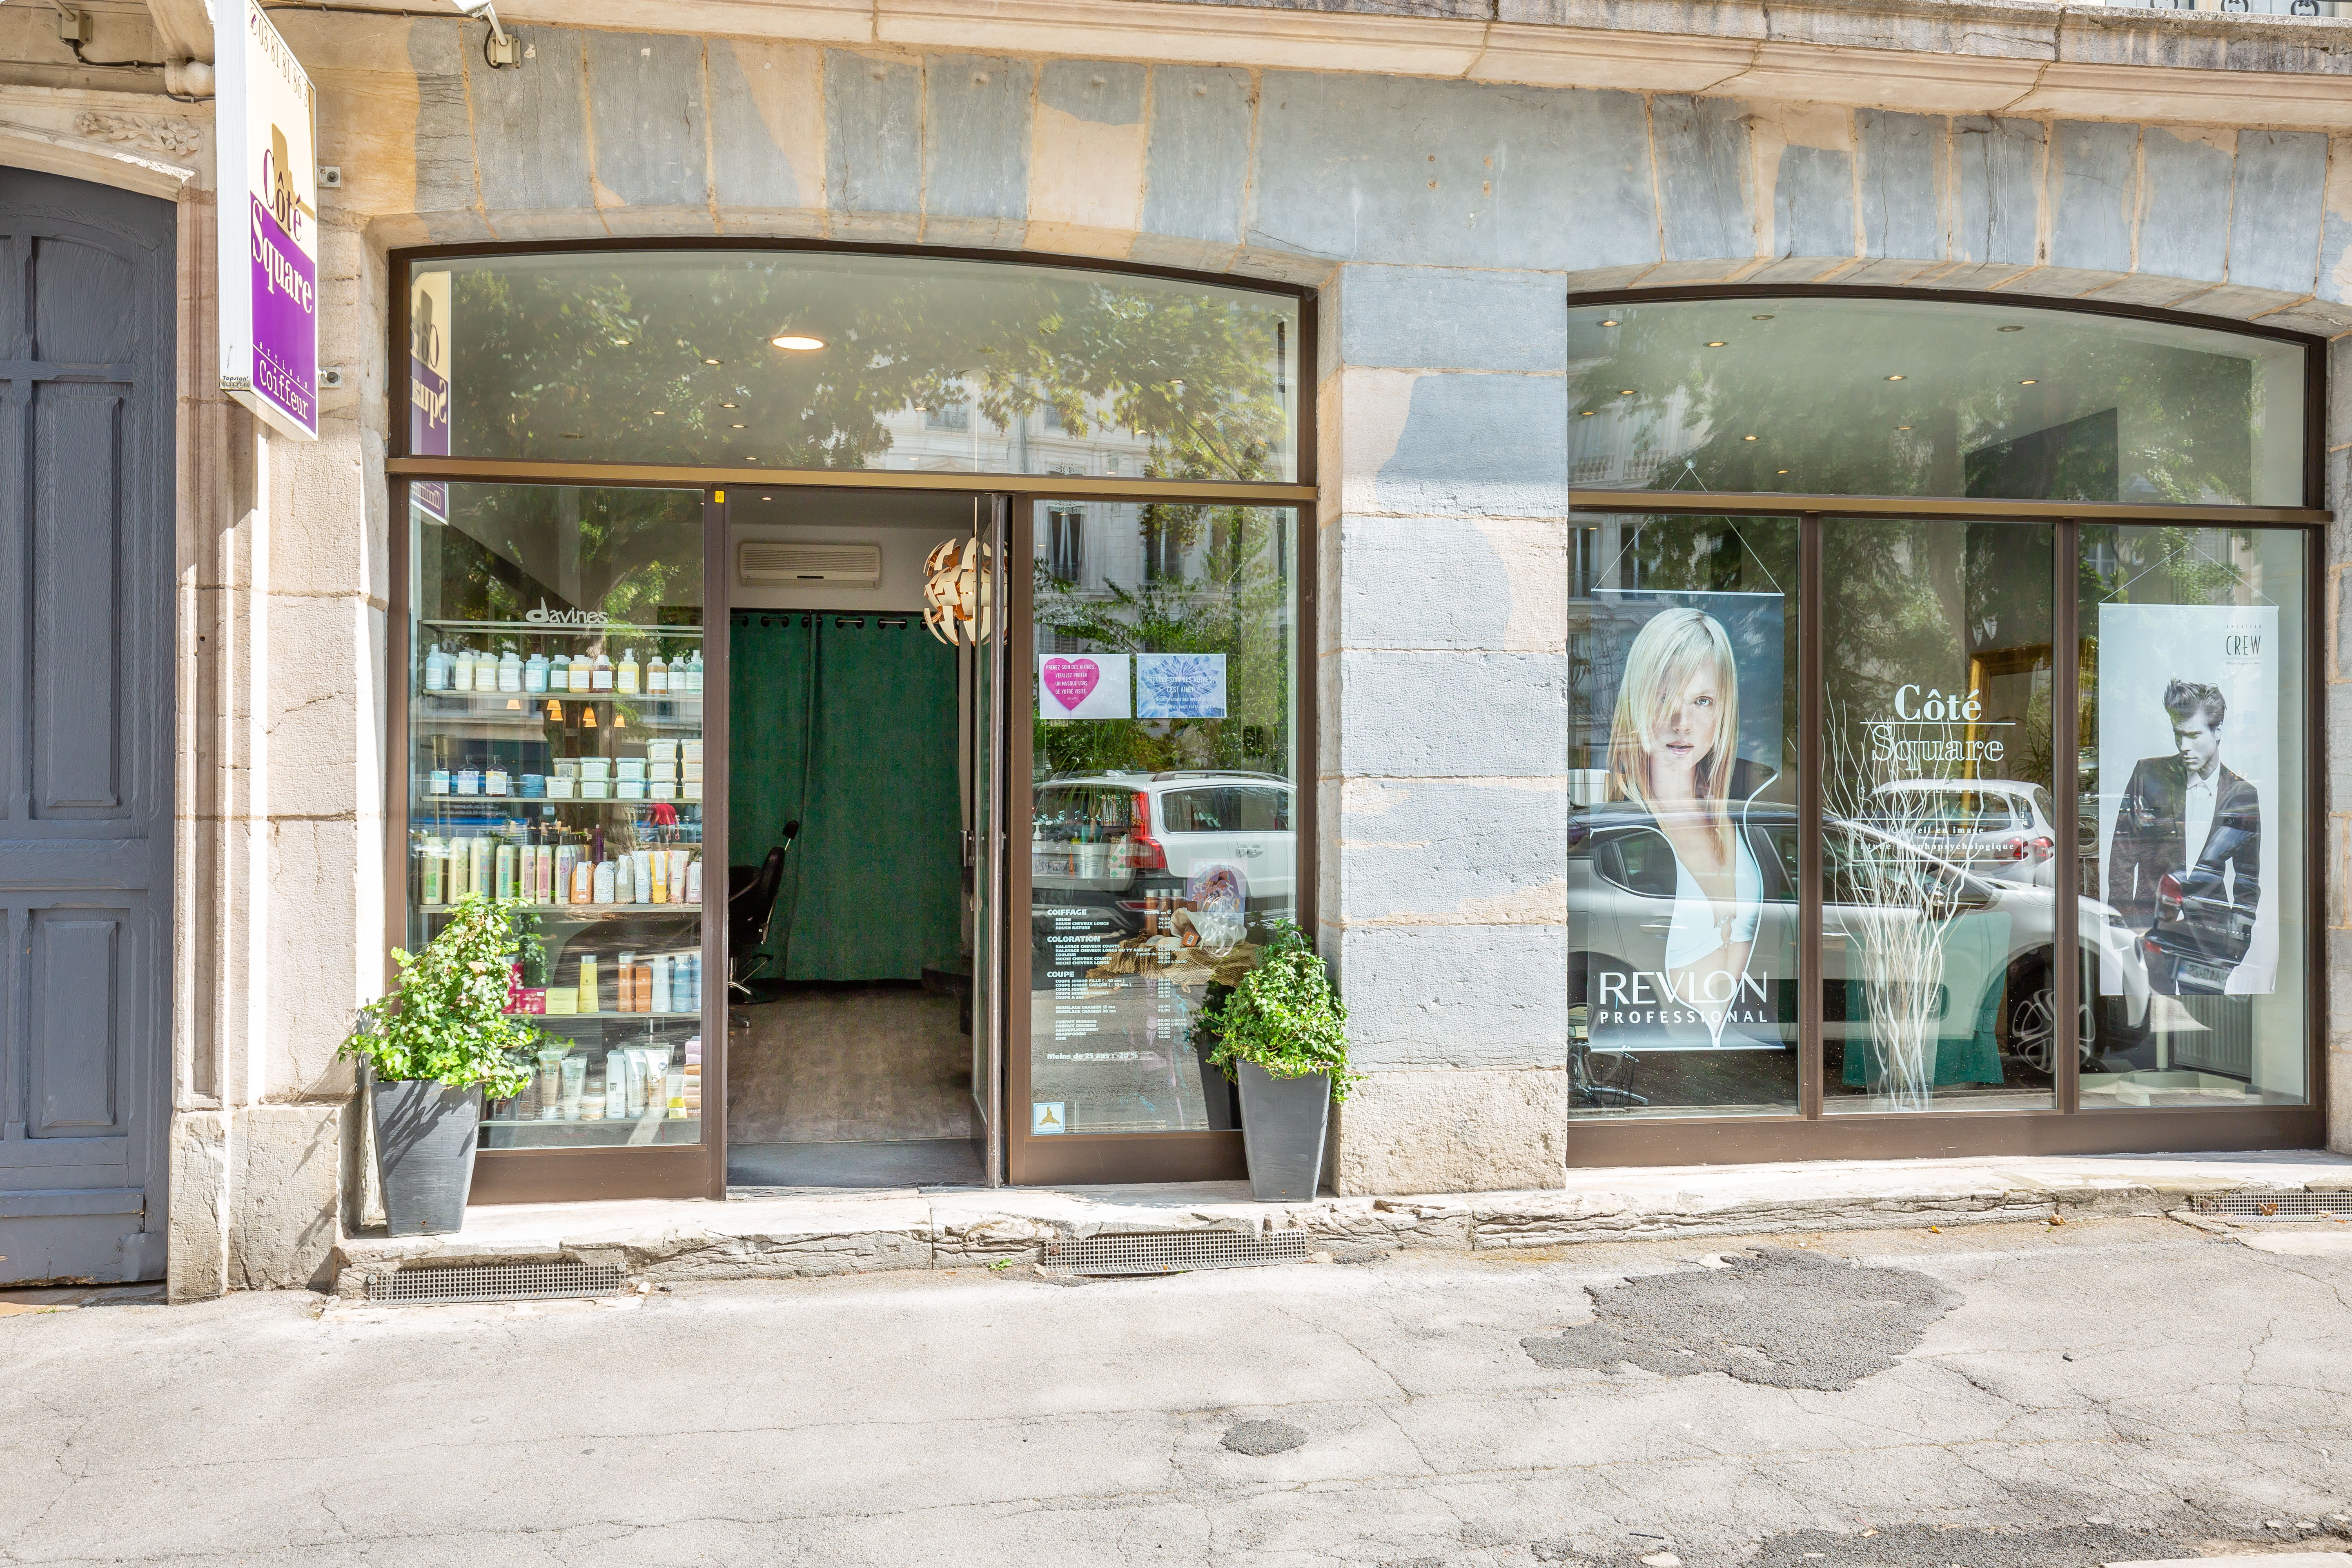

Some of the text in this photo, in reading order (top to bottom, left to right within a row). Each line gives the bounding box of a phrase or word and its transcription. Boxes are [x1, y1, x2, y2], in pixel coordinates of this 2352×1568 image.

[259, 18, 311, 114] 03 81 81 86 31
[263, 149, 302, 241] Côté
[252, 199, 312, 314] Square
[259, 341, 308, 389] artisan
[260, 360, 308, 420] Coiffeur
[526, 596, 608, 624] davines
[2226, 635, 2261, 655] CREW
[1895, 684, 1982, 721] Côté
[1871, 724, 2004, 771] Square
[1896, 842, 2014, 851] mrphopsychologique
[1953, 826, 1984, 835] image
[1599, 970, 1767, 1004] REVLON
[1600, 1010, 1768, 1024] PROFESSIONAL
